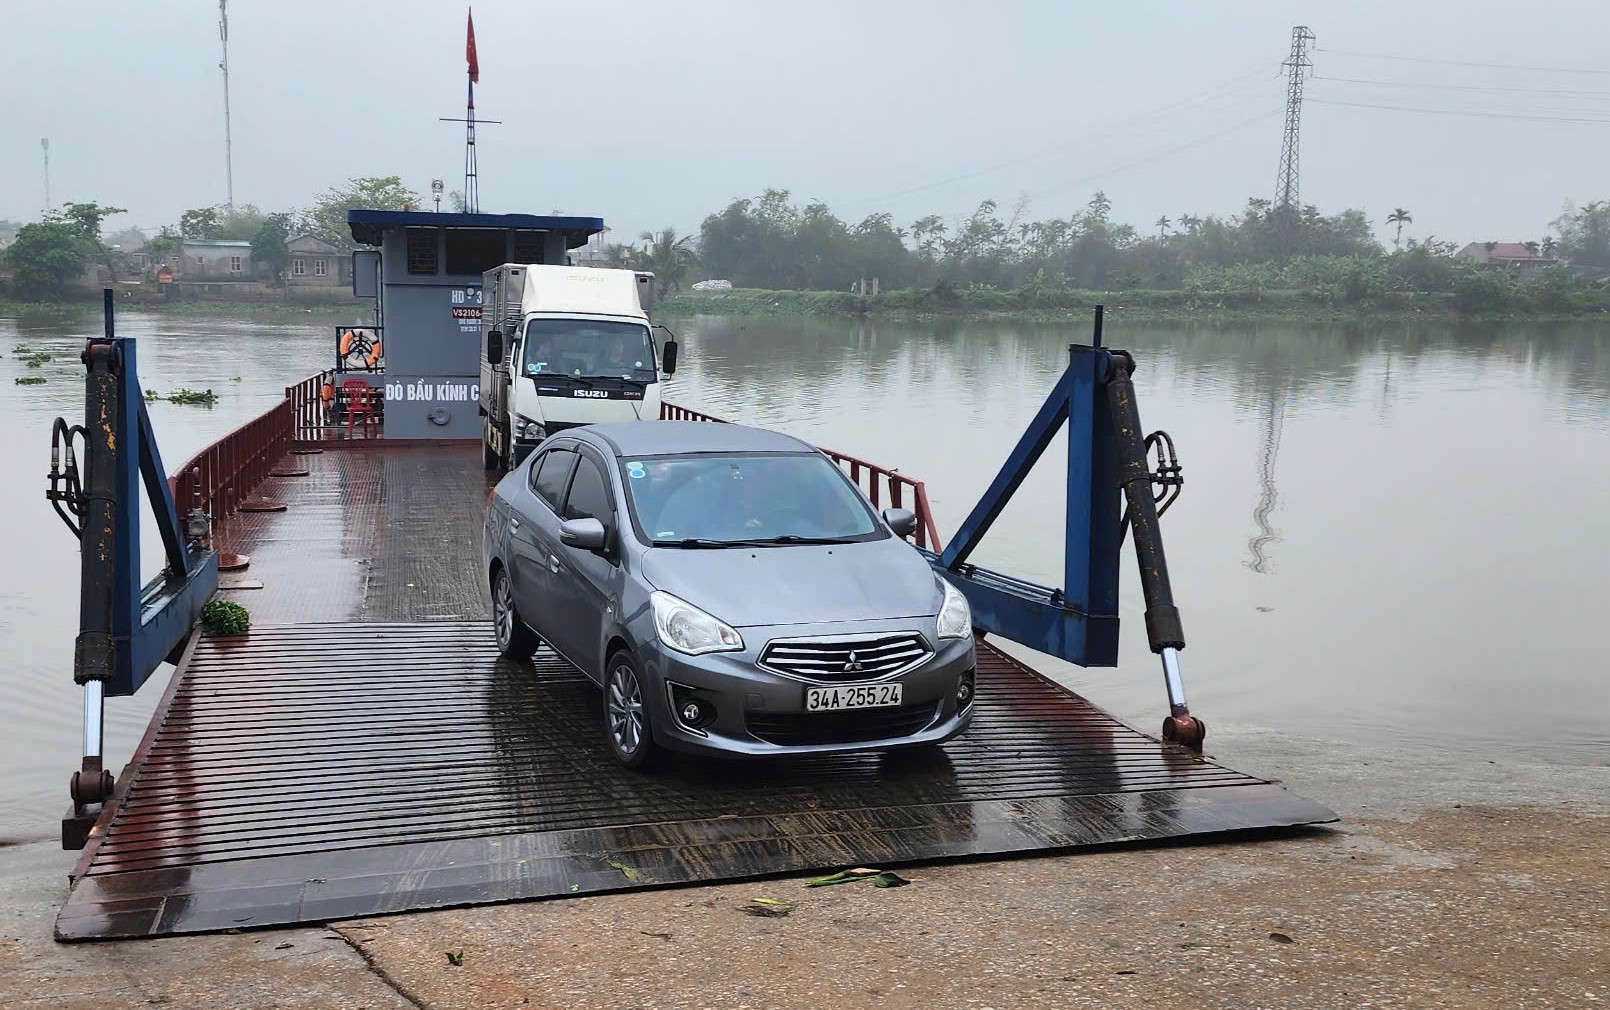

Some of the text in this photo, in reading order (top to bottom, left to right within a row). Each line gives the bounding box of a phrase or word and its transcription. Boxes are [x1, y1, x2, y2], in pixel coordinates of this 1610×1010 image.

[452, 290, 464, 303] HD
[385, 380, 404, 401] ĐÒ
[407, 378, 433, 401] BẦU
[436, 381, 468, 401] KÍNH
[574, 390, 608, 398] ISUZU
[810, 686, 899, 709] 34A-255.24
